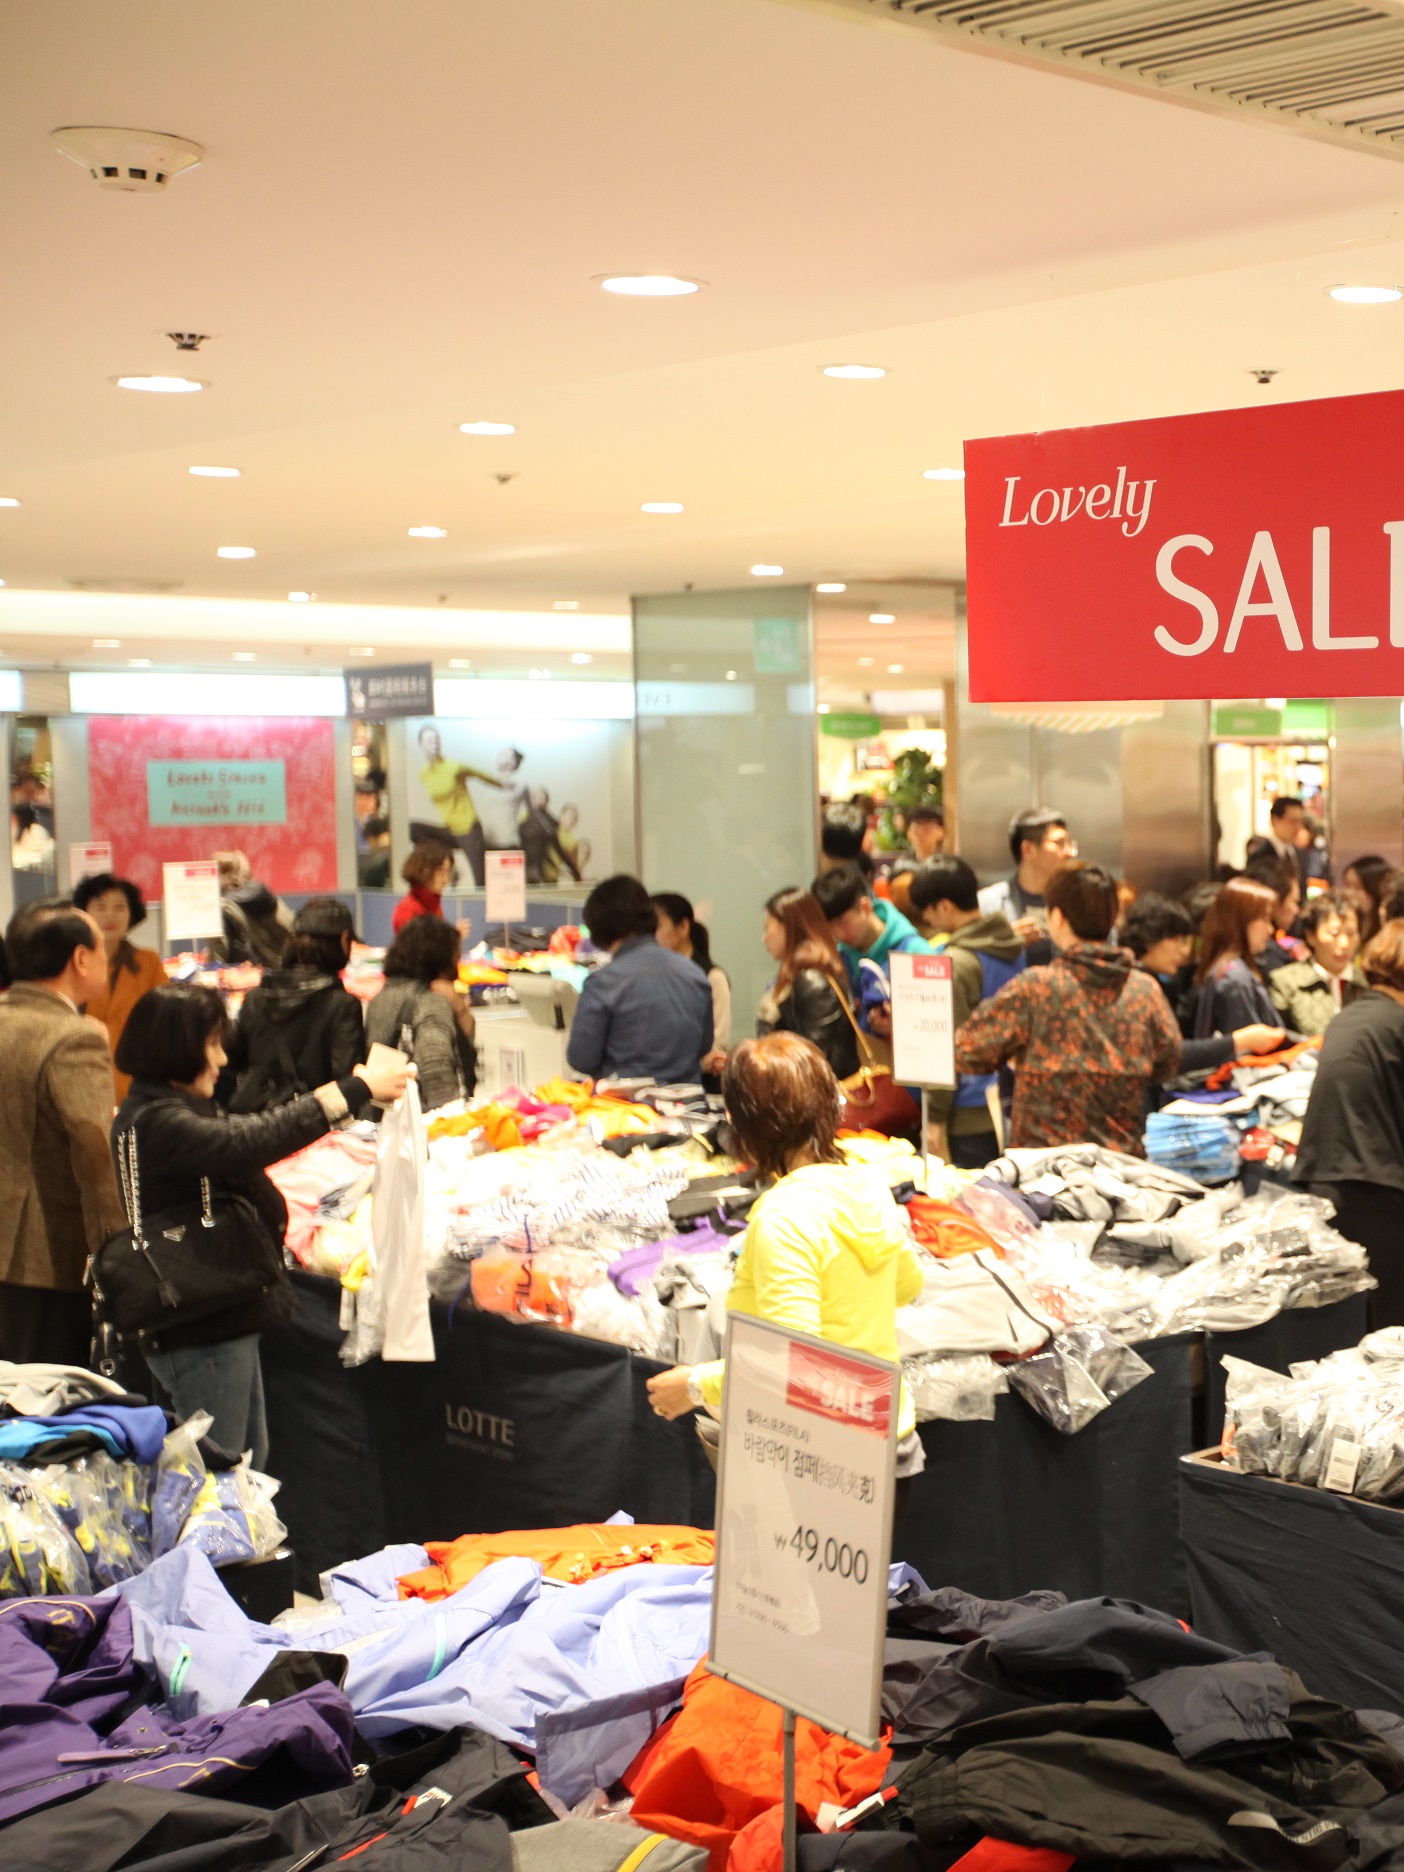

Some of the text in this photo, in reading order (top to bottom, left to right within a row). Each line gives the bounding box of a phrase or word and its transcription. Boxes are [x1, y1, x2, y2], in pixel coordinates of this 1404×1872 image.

[999, 466, 1157, 537] Lovely
[820, 1380, 875, 1423] SALE
[445, 1402, 515, 1447] LOTTE
[743, 1431, 789, 1474] 바람막이
